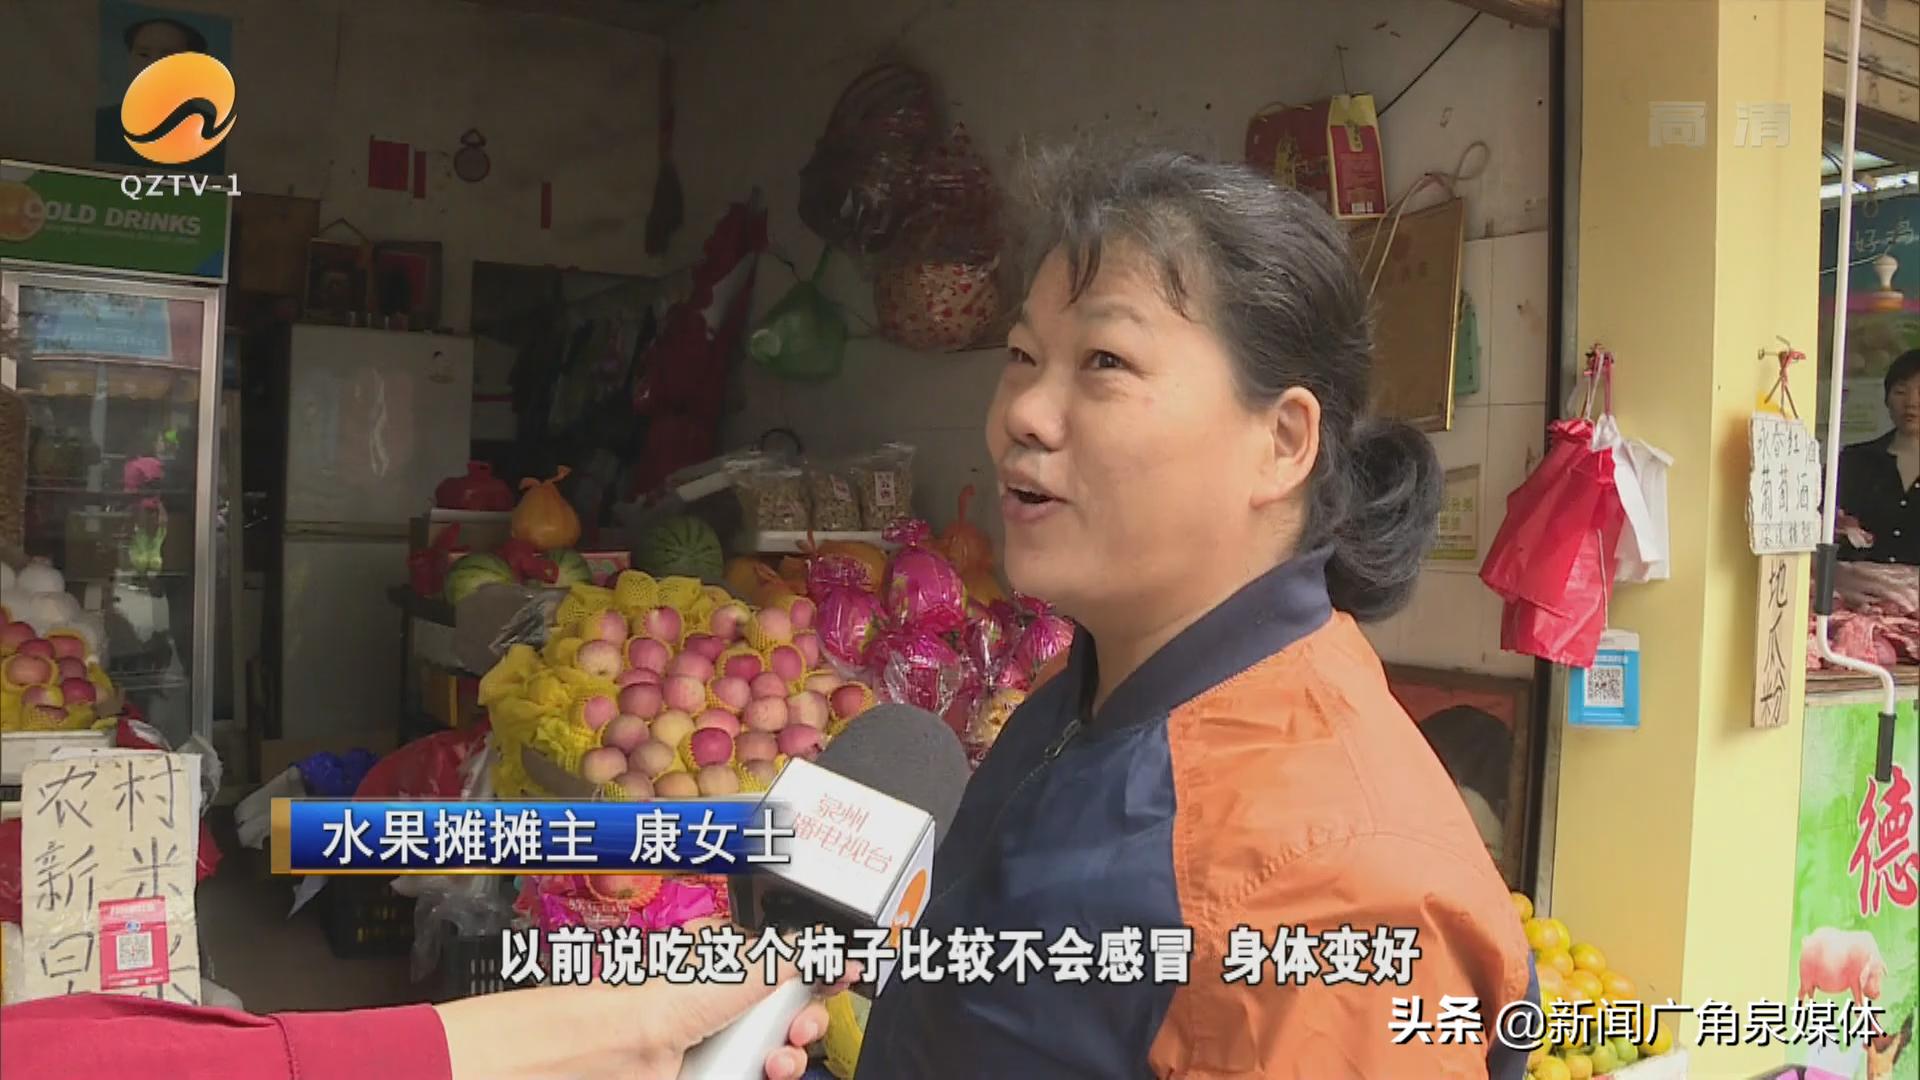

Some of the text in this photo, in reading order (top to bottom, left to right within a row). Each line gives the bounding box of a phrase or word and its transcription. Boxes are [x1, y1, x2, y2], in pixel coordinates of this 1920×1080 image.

[1760, 558, 1788, 727] 地瓜粉
[36, 755, 183, 832] 农村
[818, 793, 869, 832] 泉州
[34, 836, 187, 912] 新米
[793, 811, 892, 873] 播电视台
[1849, 764, 1920, 916] 德
